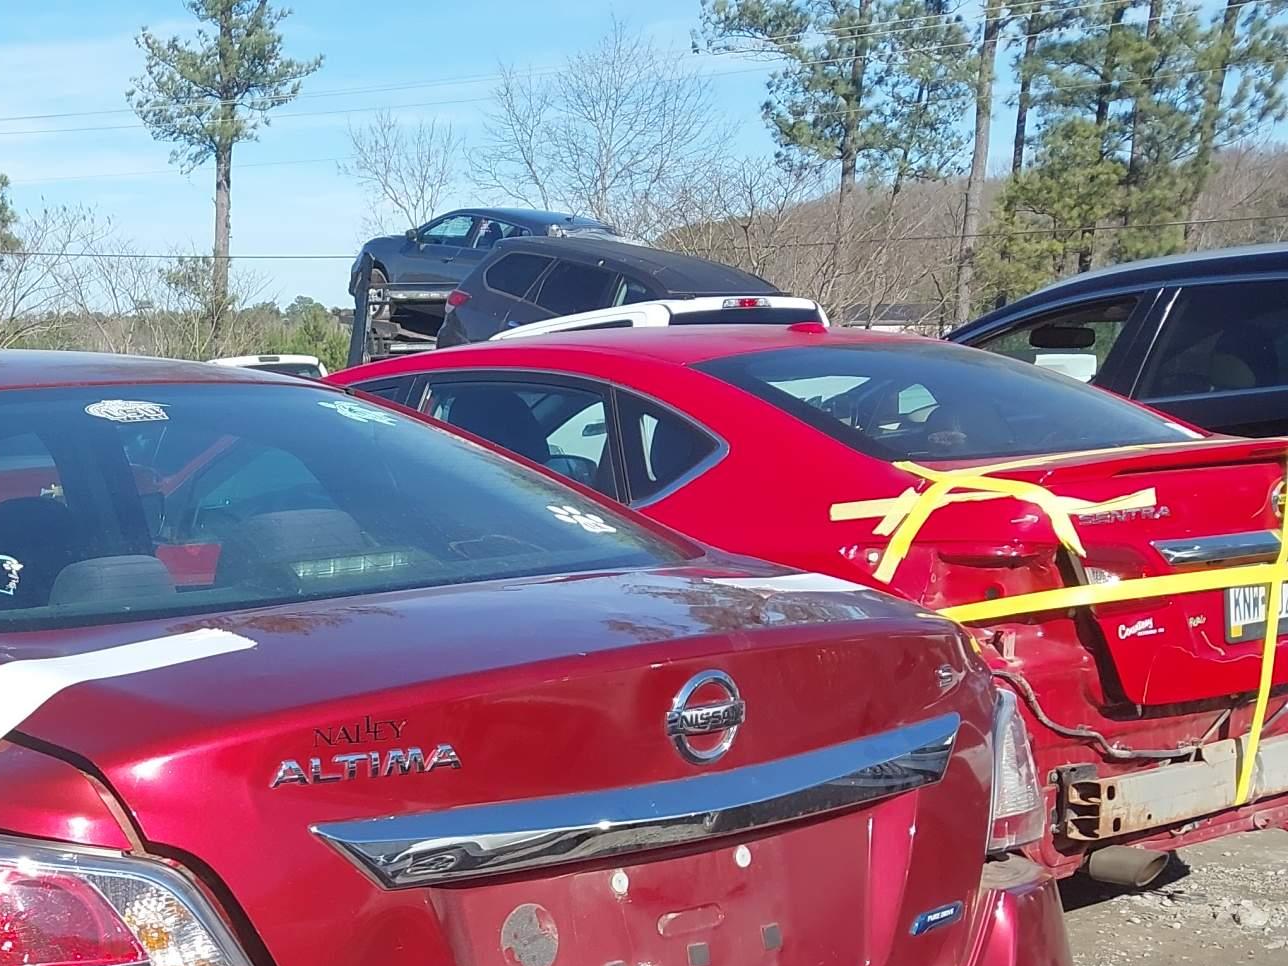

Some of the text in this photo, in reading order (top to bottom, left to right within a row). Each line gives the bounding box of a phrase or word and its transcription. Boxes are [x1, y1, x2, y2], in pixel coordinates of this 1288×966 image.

[1078, 506, 1170, 525] SENTRA
[679, 703, 739, 729] NISSAN
[313, 715, 408, 747] NALLEY
[269, 743, 462, 788] ALTIMA
